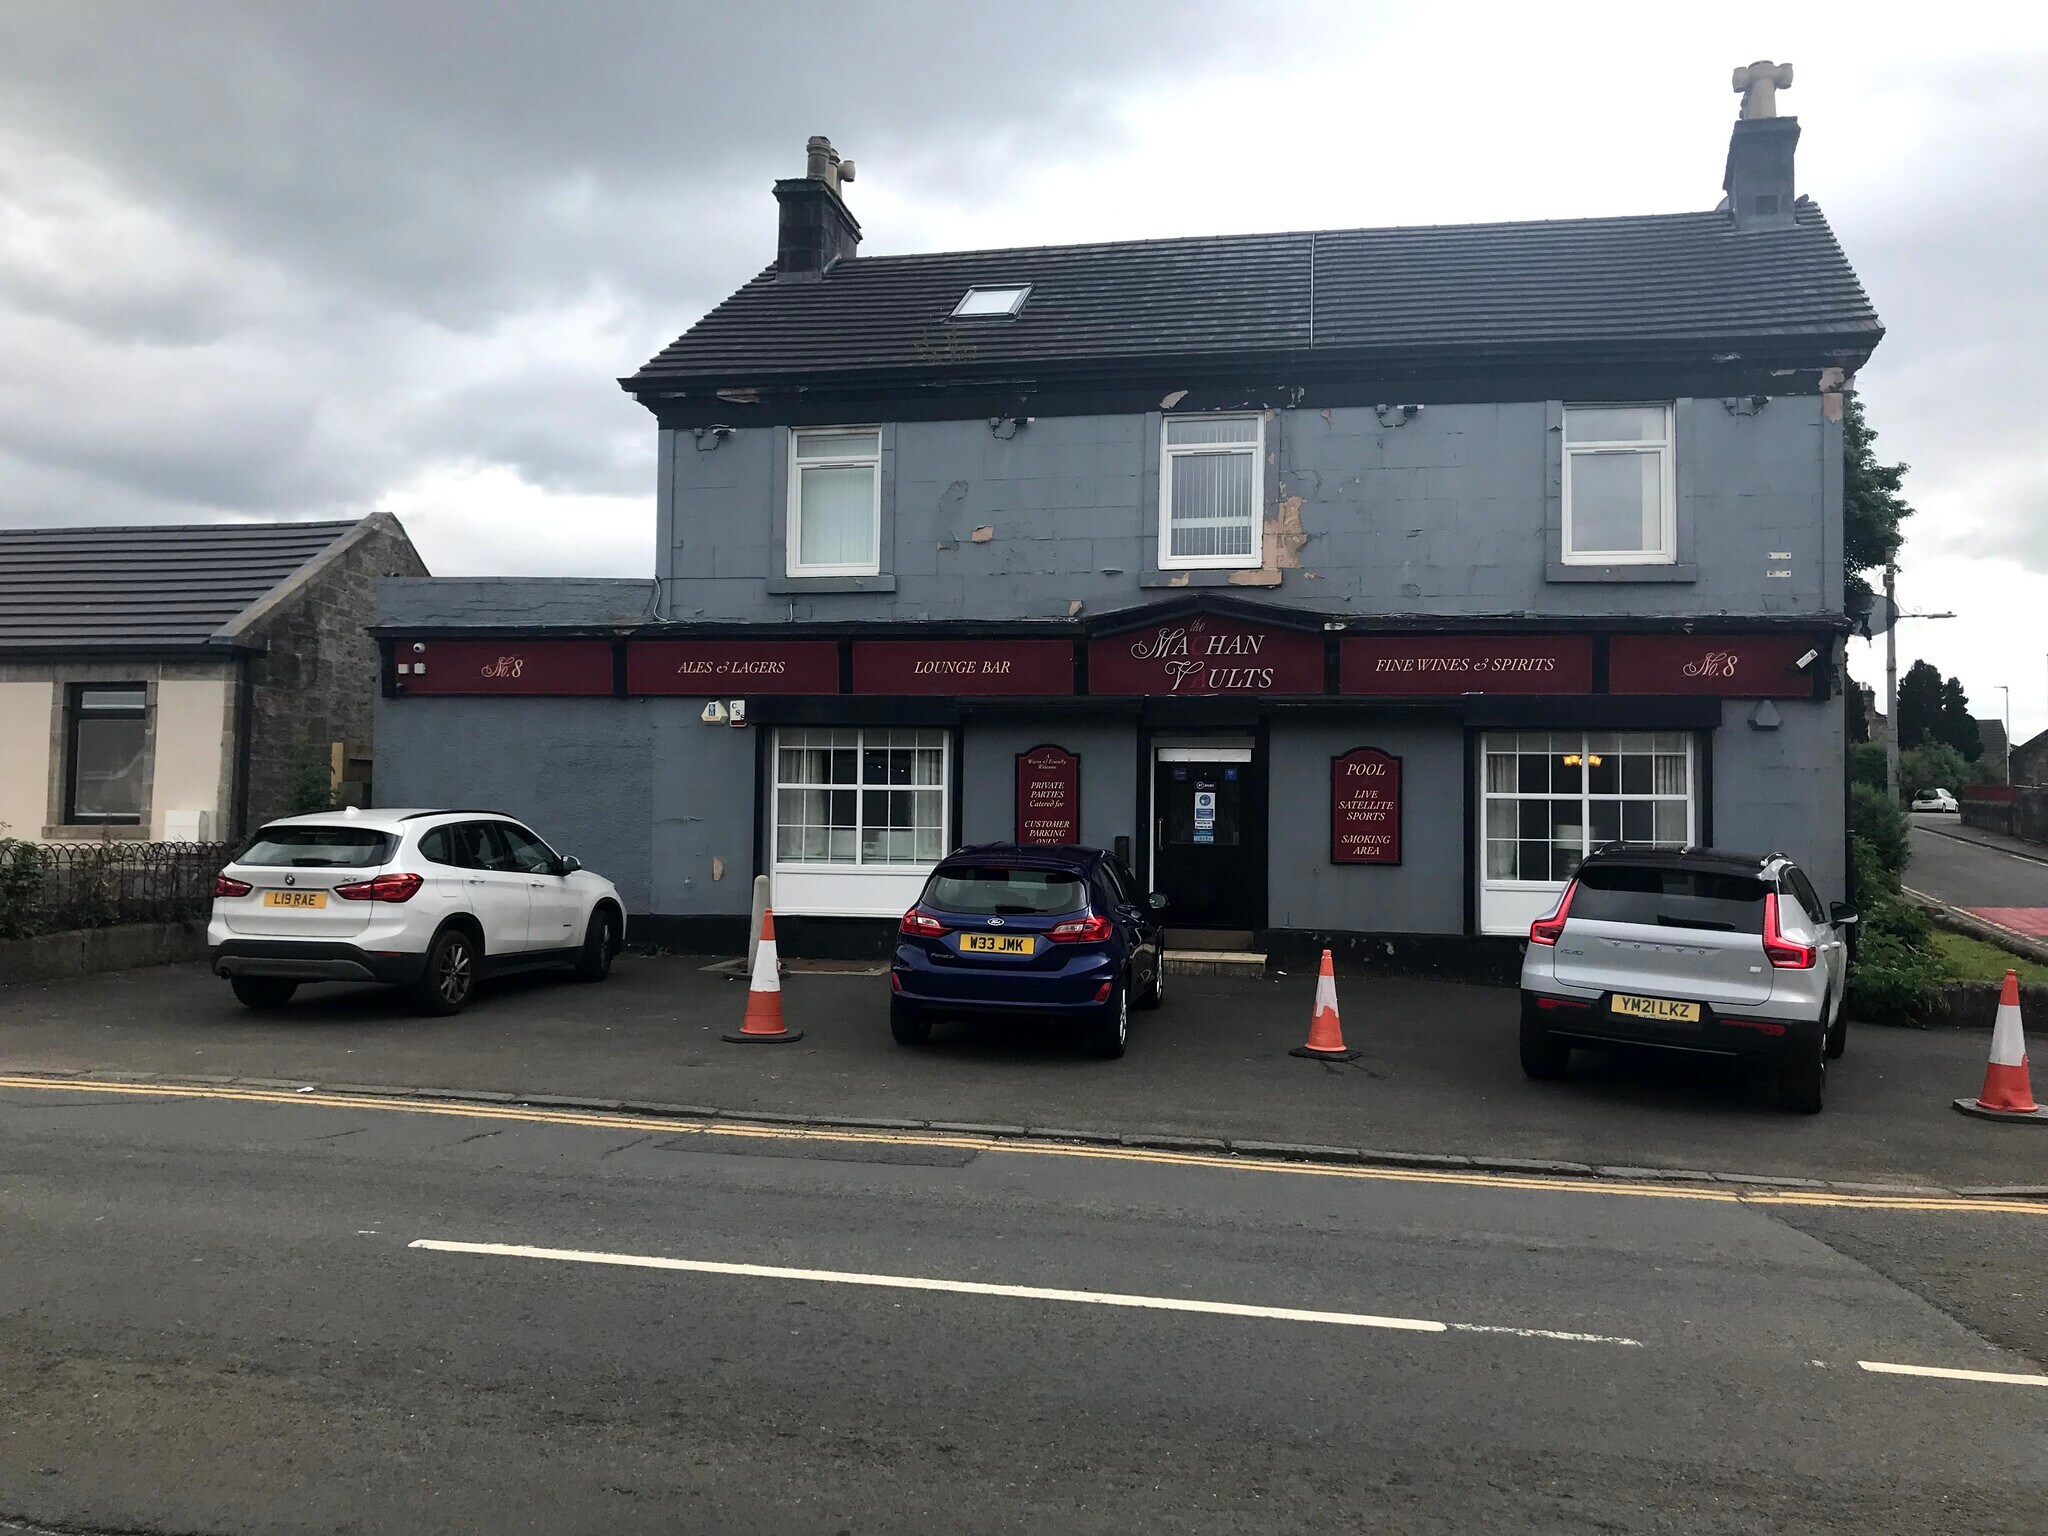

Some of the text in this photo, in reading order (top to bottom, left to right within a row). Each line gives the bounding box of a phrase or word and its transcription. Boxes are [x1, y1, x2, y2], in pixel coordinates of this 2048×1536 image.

[1189, 616, 1206, 633] the
[511, 659, 523, 678] 8
[678, 660, 786, 674] ALES & LAGERS
[914, 661, 1011, 674] LOUNGE BAR
[1375, 657, 1556, 672] FINE WINES & SPIRITS
[1723, 655, 1738, 677] 8
[1346, 763, 1386, 776] POOL
[1030, 781, 1065, 790] PRIVATE
[1030, 790, 1065, 799] PARTIES
[1354, 790, 1379, 799] LIVE
[1029, 799, 1065, 810] Catered for
[1338, 801, 1395, 811] SATELLITE
[1346, 811, 1386, 821] SPORTS
[1024, 820, 1071, 829] CUSTOMER
[1029, 829, 1066, 838] PARKING
[1341, 834, 1391, 845] SMOKING
[1353, 846, 1380, 855] AREA
[273, 893, 317, 906] L19 RAE
[970, 936, 1024, 952] W33 JMK
[1613, 940, 1706, 955] VOLVO
[1622, 996, 1690, 1018] YM21 LKZ
